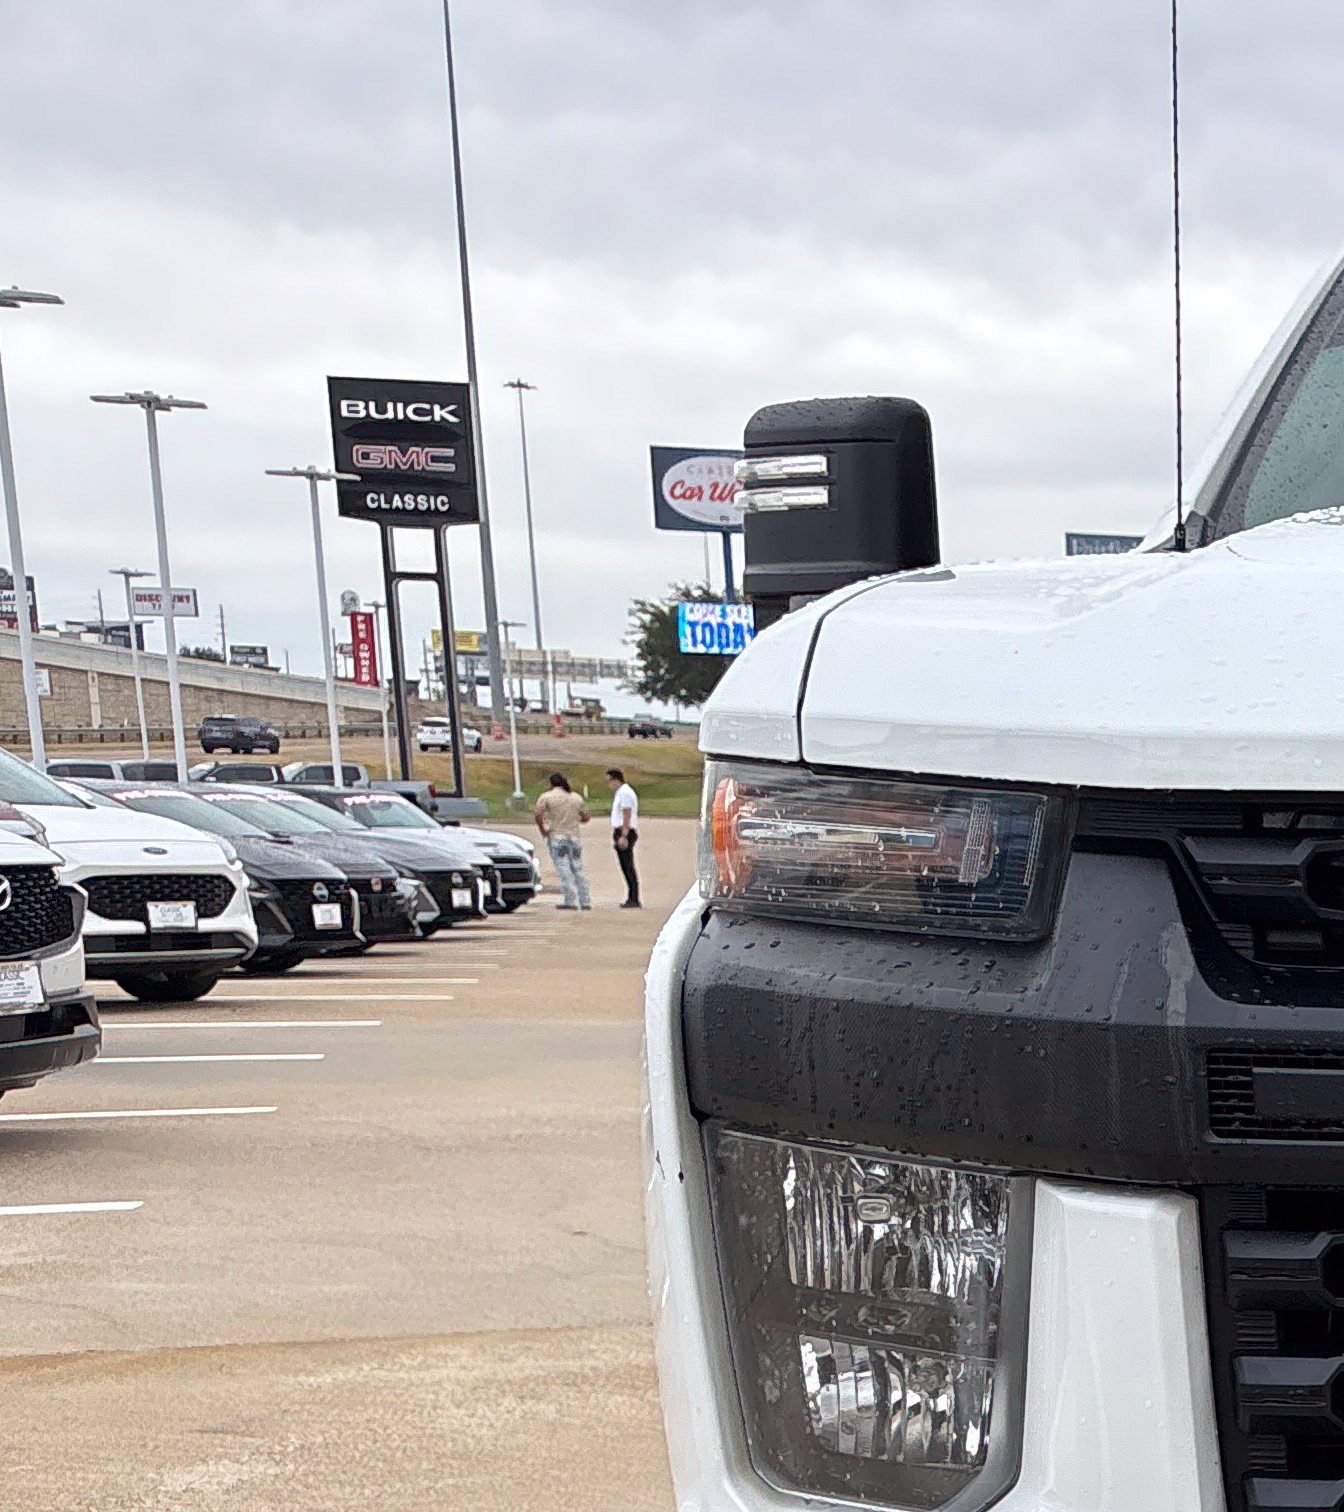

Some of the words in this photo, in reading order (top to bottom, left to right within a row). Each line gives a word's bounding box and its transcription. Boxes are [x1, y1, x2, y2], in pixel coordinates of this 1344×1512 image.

[340, 400, 460, 422] BUICK
[353, 444, 456, 472] GMC
[366, 492, 450, 512] CLASSIC
